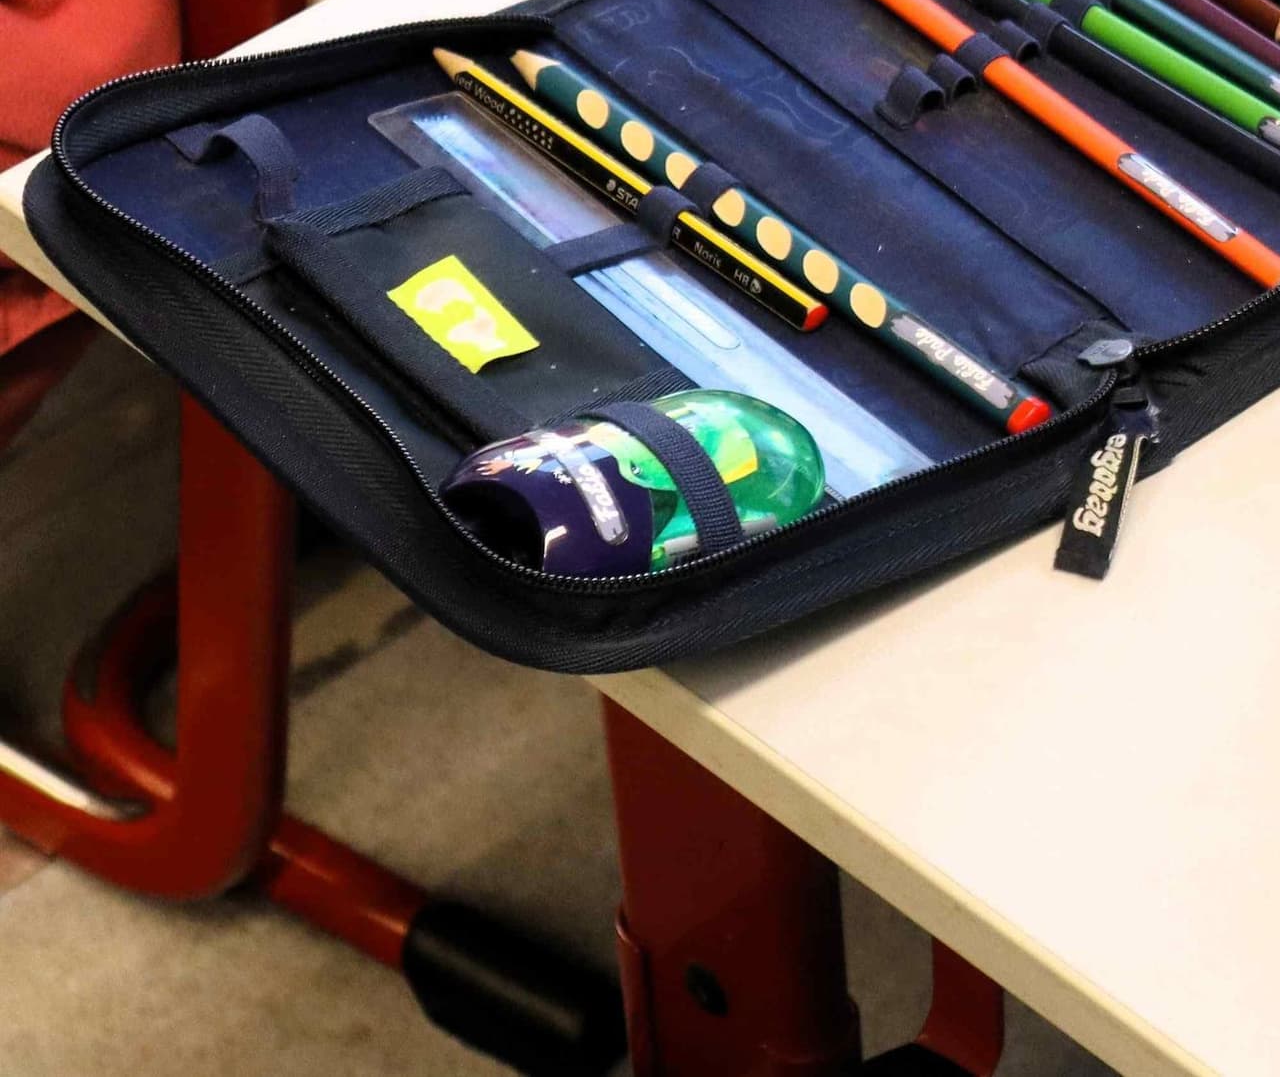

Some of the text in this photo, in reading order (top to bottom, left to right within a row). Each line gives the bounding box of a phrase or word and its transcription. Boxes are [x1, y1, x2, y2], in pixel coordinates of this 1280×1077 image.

[474, 84, 505, 115] Wood
[615, 187, 640, 210] STA
[693, 241, 722, 269] Noris
[915, 328, 995, 392] Fabio Pade
[575, 463, 619, 522] Fabio
[1073, 433, 1127, 537] ergobag
